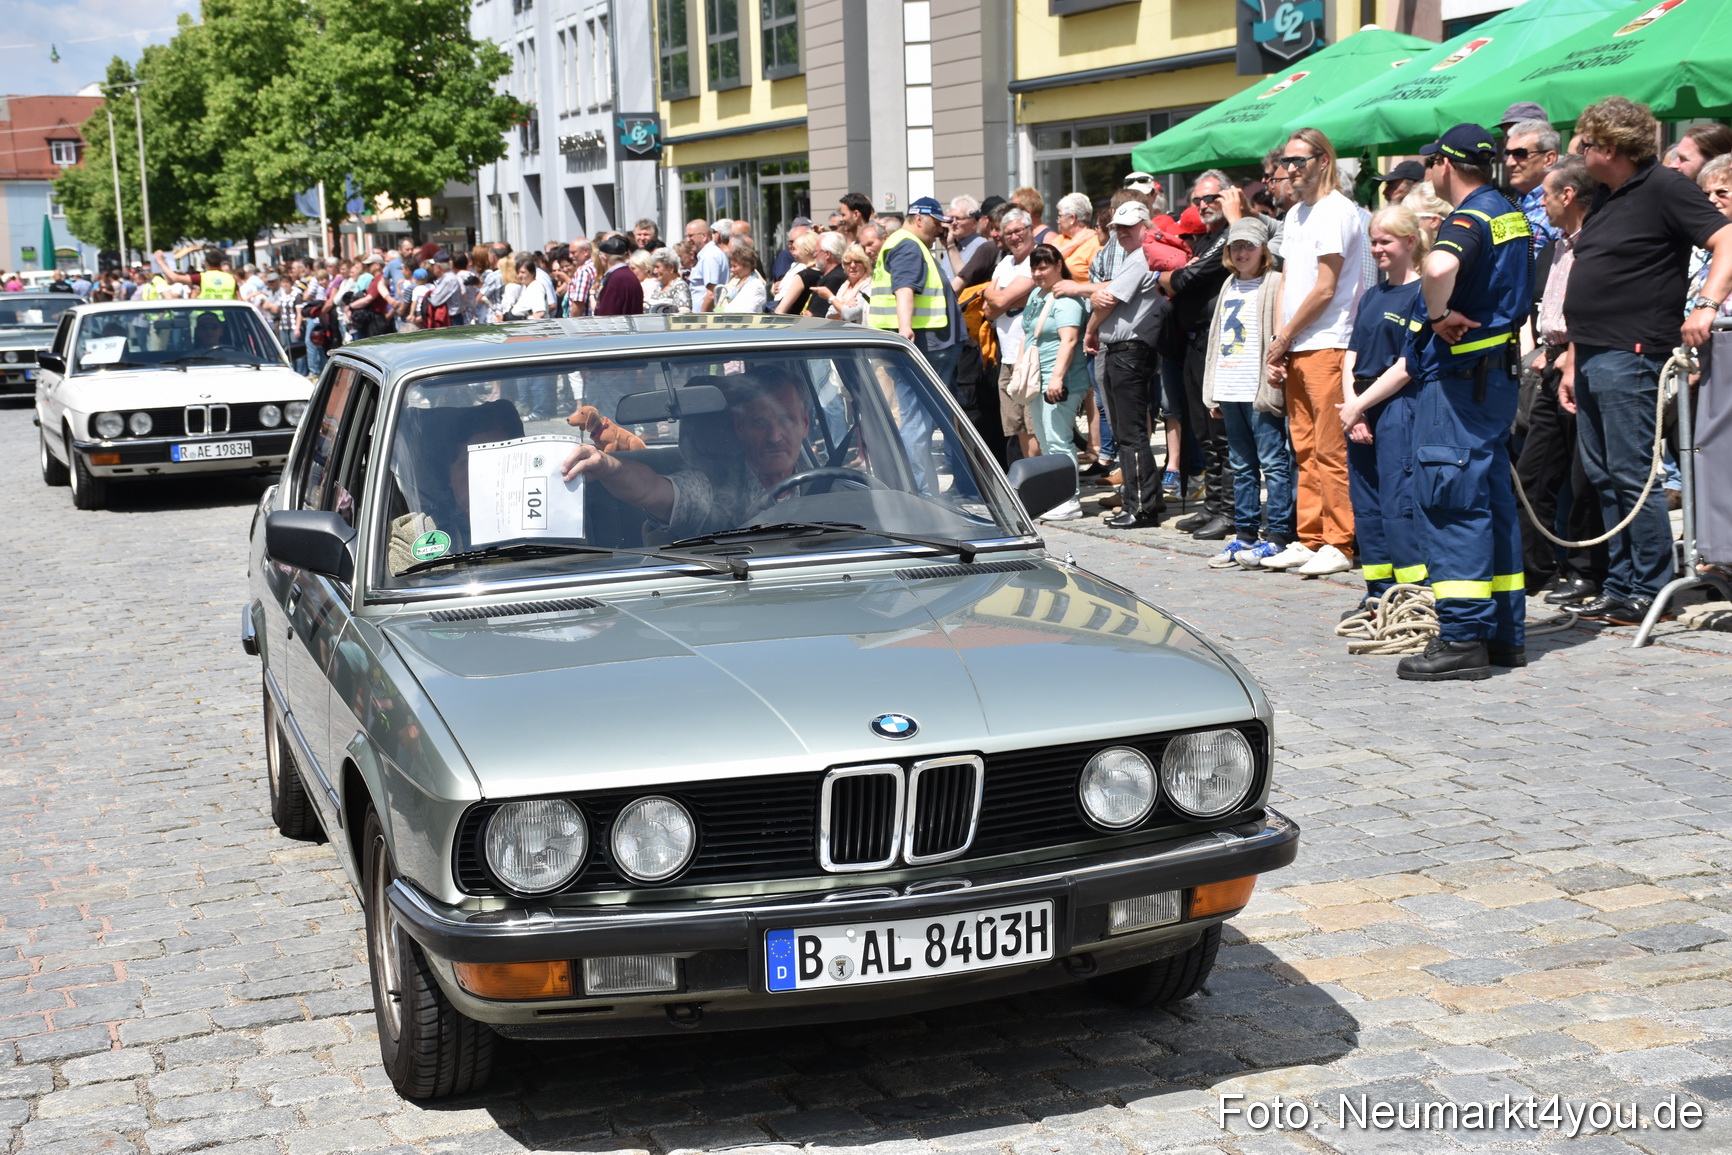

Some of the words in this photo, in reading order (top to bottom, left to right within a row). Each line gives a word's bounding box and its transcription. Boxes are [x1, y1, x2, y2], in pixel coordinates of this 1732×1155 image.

[1274, 2, 1304, 42] G2
[631, 125, 648, 145] G2
[180, 447, 187, 459] R
[197, 445, 212, 457] AE
[216, 442, 251, 456] 1983H
[527, 488, 542, 519] 104
[425, 532, 437, 545] 4
[797, 935, 823, 981] B
[860, 928, 912, 976] AL
[925, 908, 1048, 969] 8403H
[777, 966, 787, 979] D
